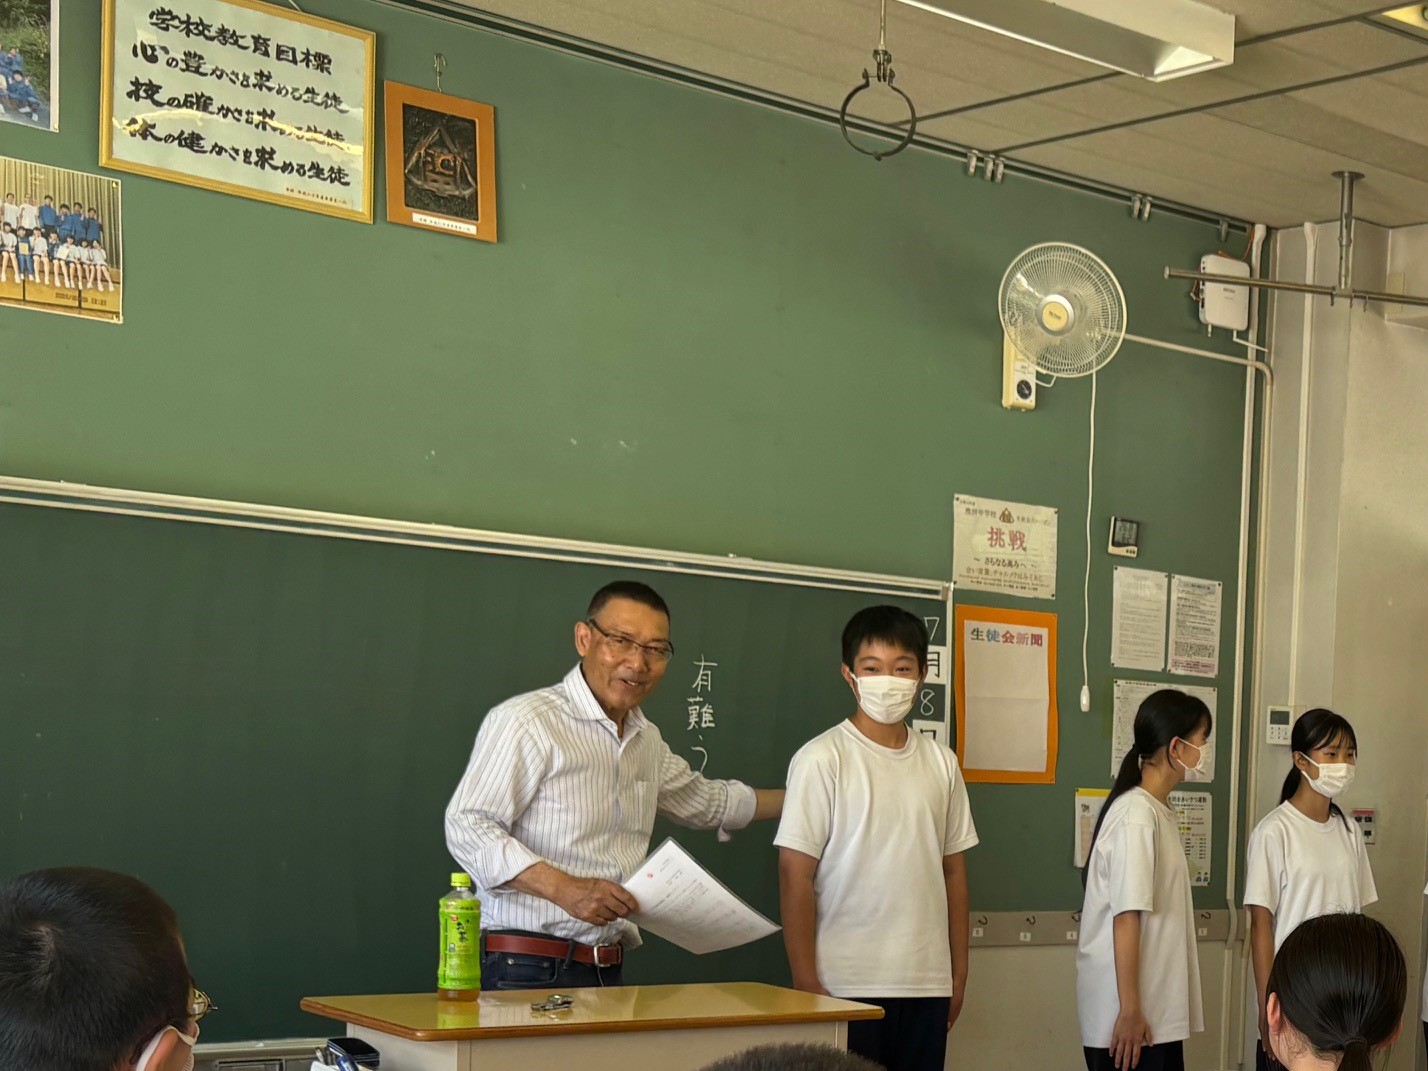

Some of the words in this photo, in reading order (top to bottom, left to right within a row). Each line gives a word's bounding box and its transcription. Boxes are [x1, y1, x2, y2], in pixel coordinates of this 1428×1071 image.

[148, 7, 332, 75] 学校教育目標
[132, 40, 350, 114] 心の豊かさを求める生徒
[987, 526, 1027, 552] 挑戦
[971, 627, 1044, 648] 生徒会新聞
